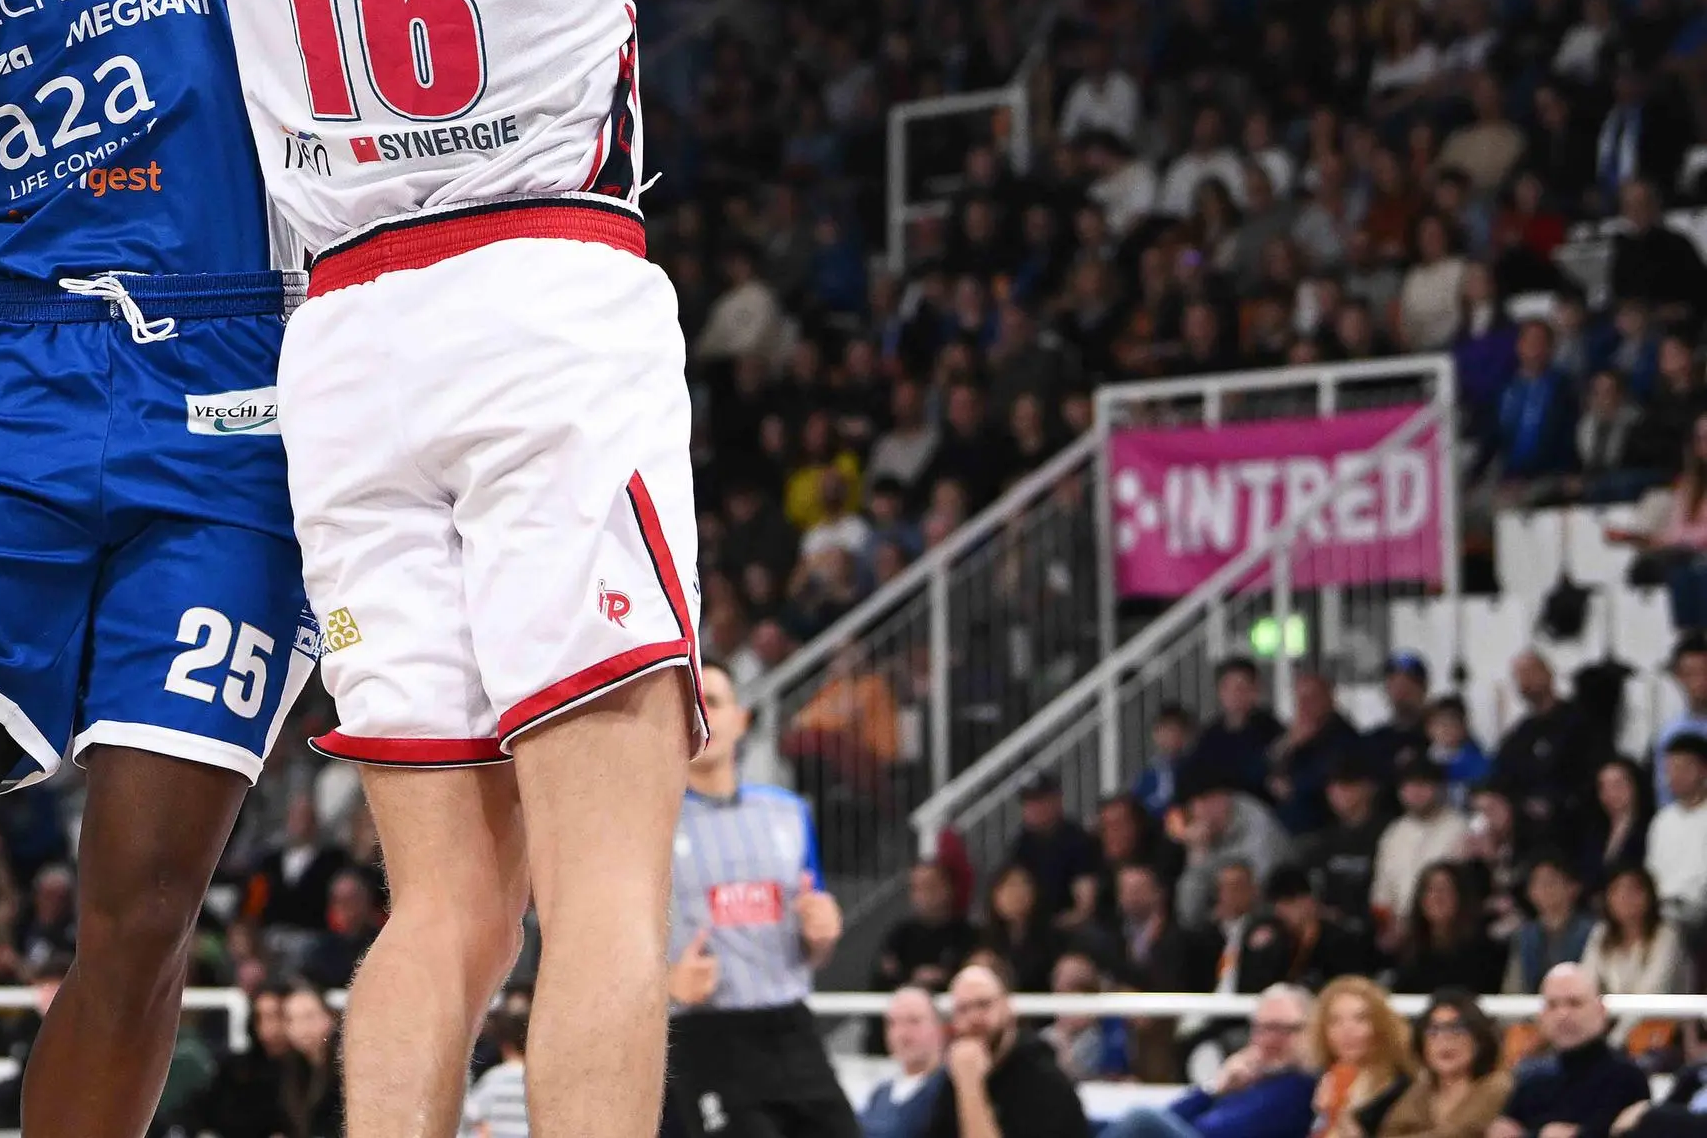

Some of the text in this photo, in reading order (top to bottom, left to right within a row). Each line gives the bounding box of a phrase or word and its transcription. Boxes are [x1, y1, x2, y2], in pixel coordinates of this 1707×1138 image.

[9, 118, 158, 200] LIFE COMPAY
[380, 115, 520, 161] SYNERGIE
[195, 405, 257, 418] VECCHI
[1163, 449, 1430, 555] INTRED
[164, 607, 275, 719] 25
